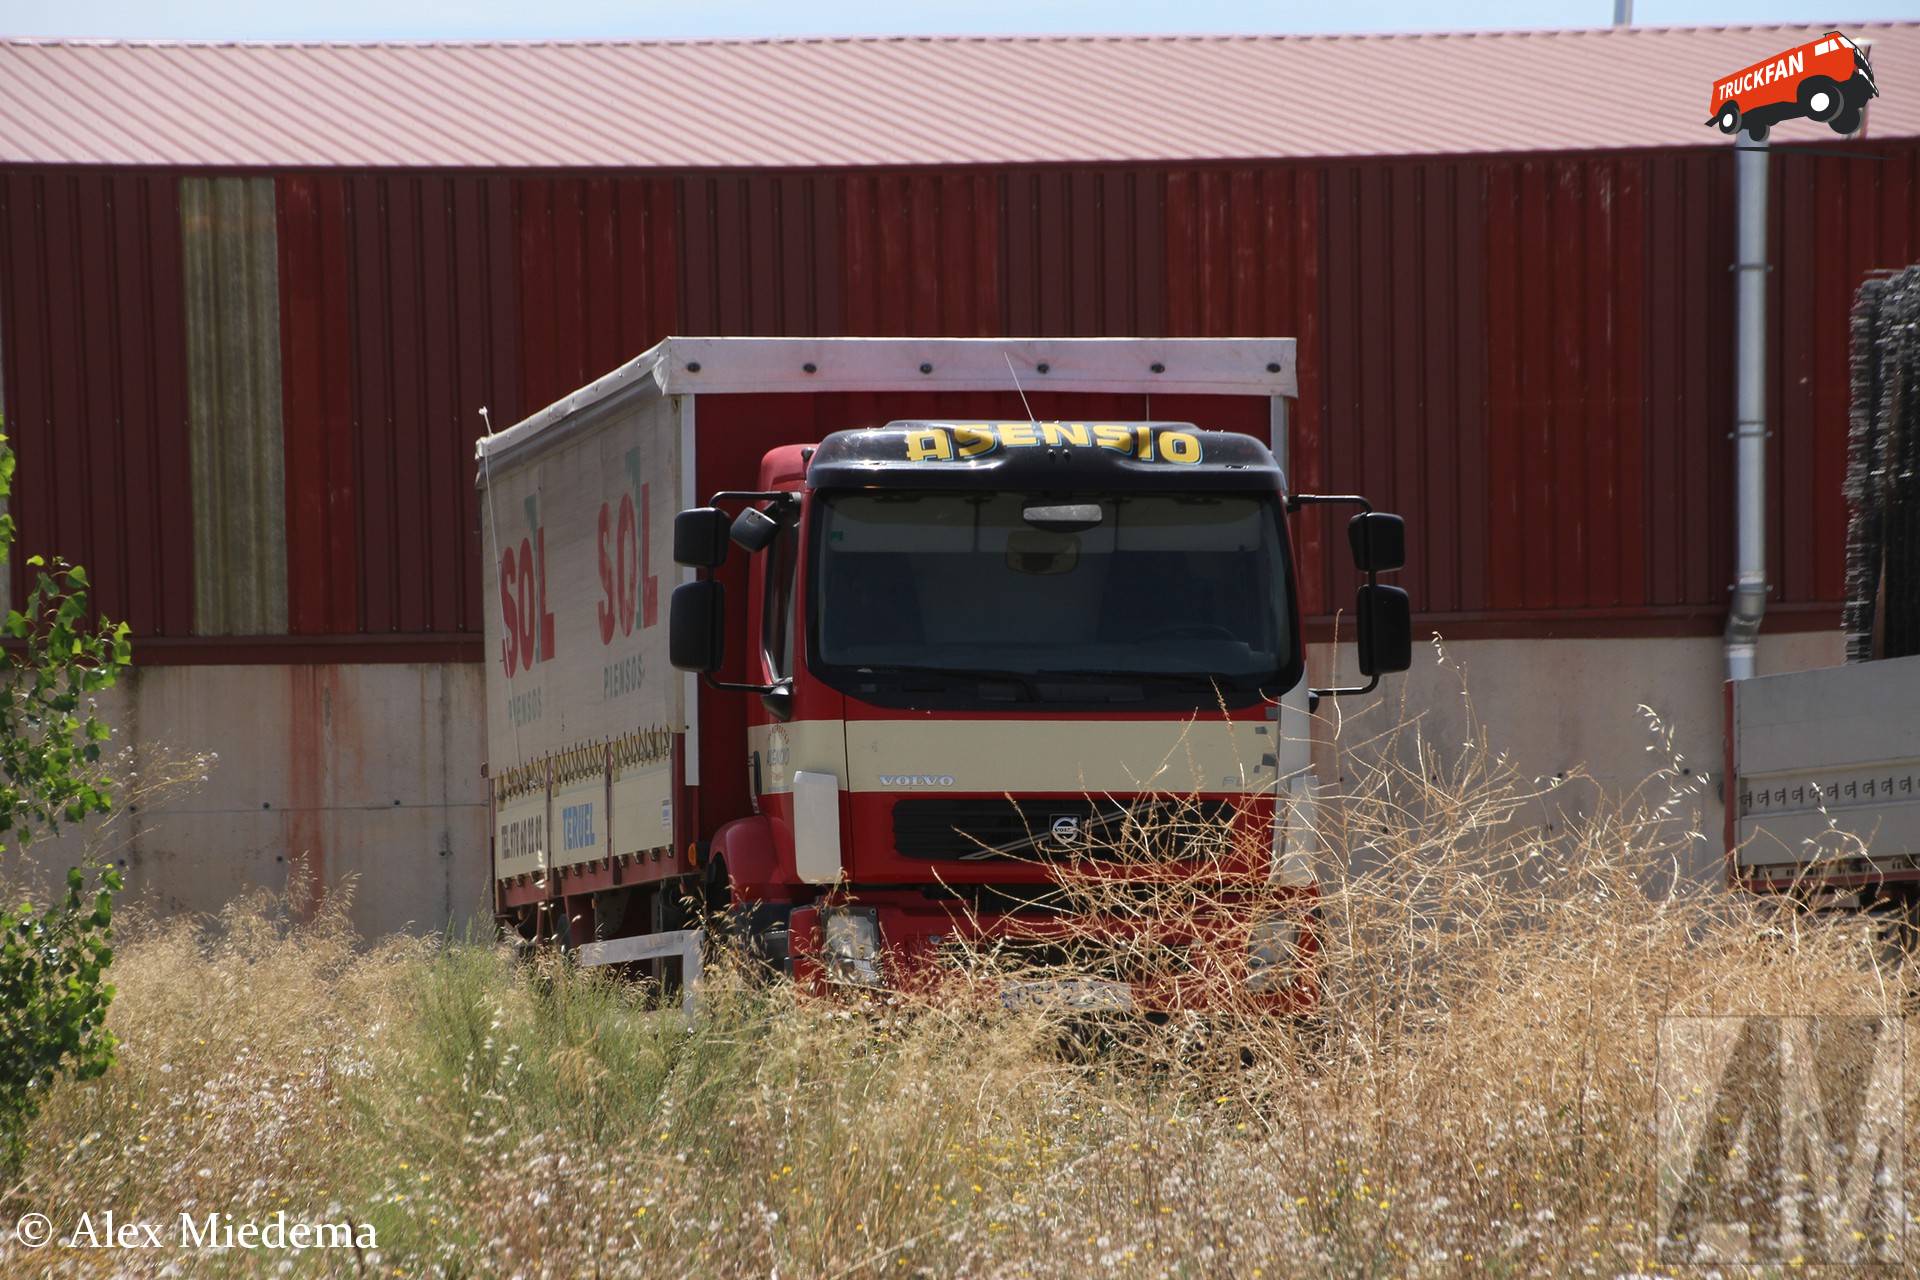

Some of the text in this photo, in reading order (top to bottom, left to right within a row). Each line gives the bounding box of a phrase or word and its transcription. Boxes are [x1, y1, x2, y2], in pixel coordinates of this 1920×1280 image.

[905, 423, 1204, 465] ASENSIO
[603, 654, 642, 700] PIENSOS
[879, 775, 955, 786] VOLVO
[562, 803, 595, 851] TERUEL
